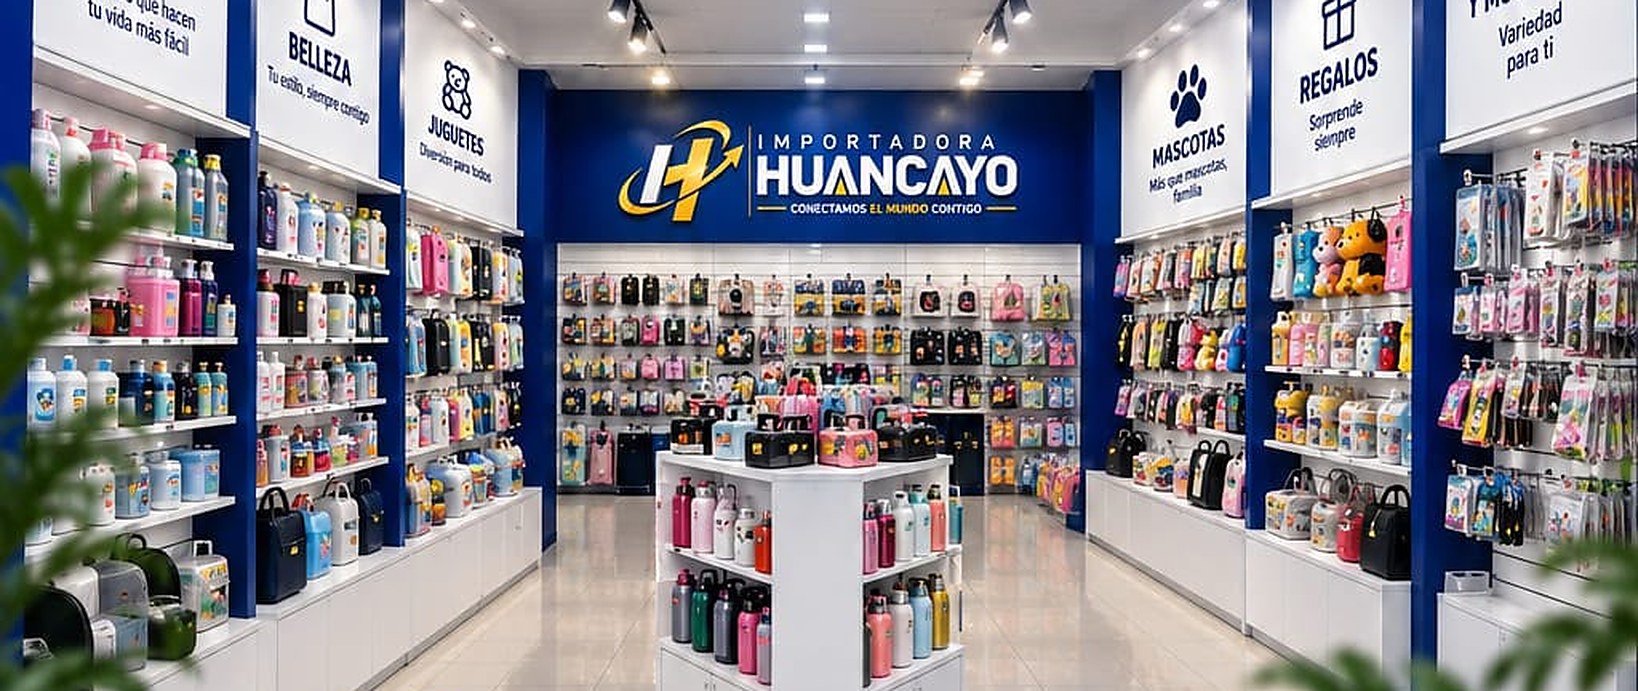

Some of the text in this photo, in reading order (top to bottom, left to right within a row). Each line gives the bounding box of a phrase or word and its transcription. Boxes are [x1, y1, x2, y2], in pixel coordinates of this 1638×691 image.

[88, 0, 189, 56] tu vida más fácil
[136, 0, 196, 31] que hacen
[1498, 1, 1562, 47] Variedad
[288, 31, 352, 87] BELLEZA
[1300, 47, 1378, 104] REGALOS
[1507, 35, 1554, 79] para ti
[267, 65, 279, 84] Tu
[306, 84, 340, 111] siempre
[428, 114, 484, 156] JUGUETES
[1309, 98, 1363, 131] Sorprende
[758, 134, 995, 150] IMPORTADORA
[1152, 123, 1226, 169] MASCOTAS
[1315, 126, 1356, 151] siempre
[756, 155, 1018, 196] HUANCAYO
[790, 203, 982, 214] CONECTAMOS EL MUNDO CONTIGO
